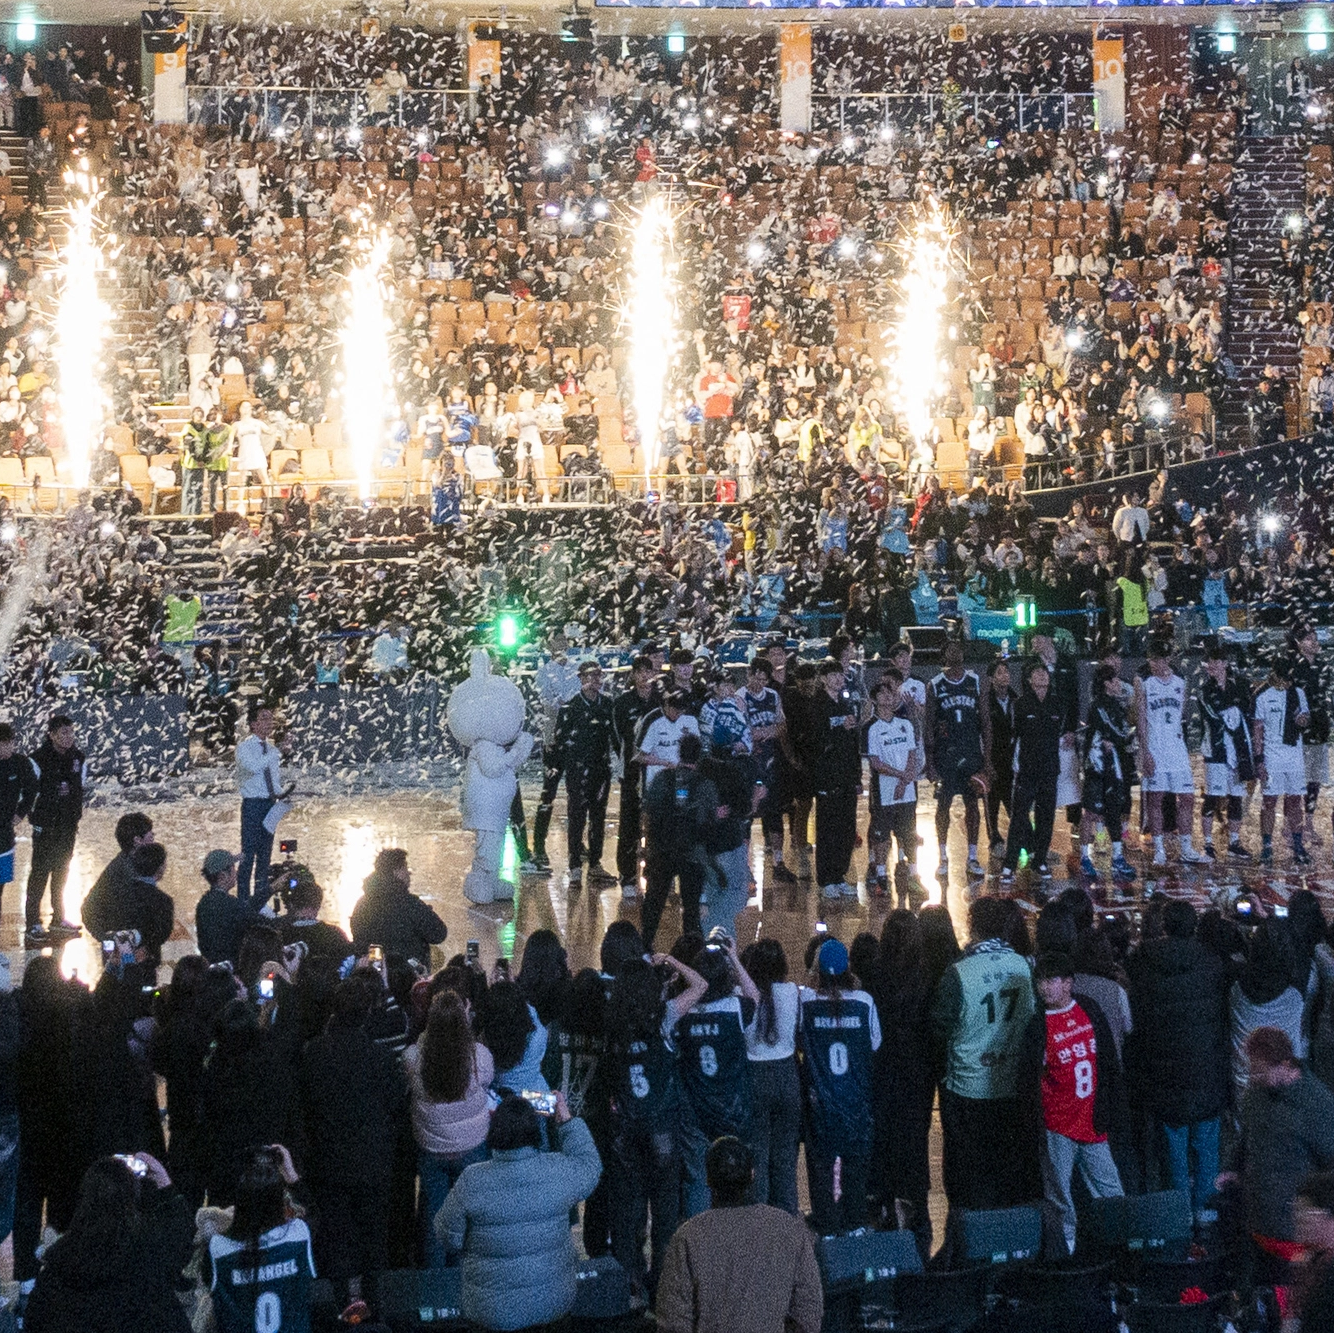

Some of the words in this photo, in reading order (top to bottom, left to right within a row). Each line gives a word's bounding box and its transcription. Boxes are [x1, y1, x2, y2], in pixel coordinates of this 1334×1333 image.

[163, 52, 179, 72] 9
[783, 60, 809, 82] 10
[1095, 58, 1121, 81] 10
[976, 628, 1014, 638] molten
[954, 709, 962, 723] 1
[980, 991, 1019, 1024] 17
[829, 1041, 848, 1076] 0
[629, 1064, 650, 1098] 5
[1074, 1059, 1093, 1099] 8
[255, 1291, 282, 1333] 0
